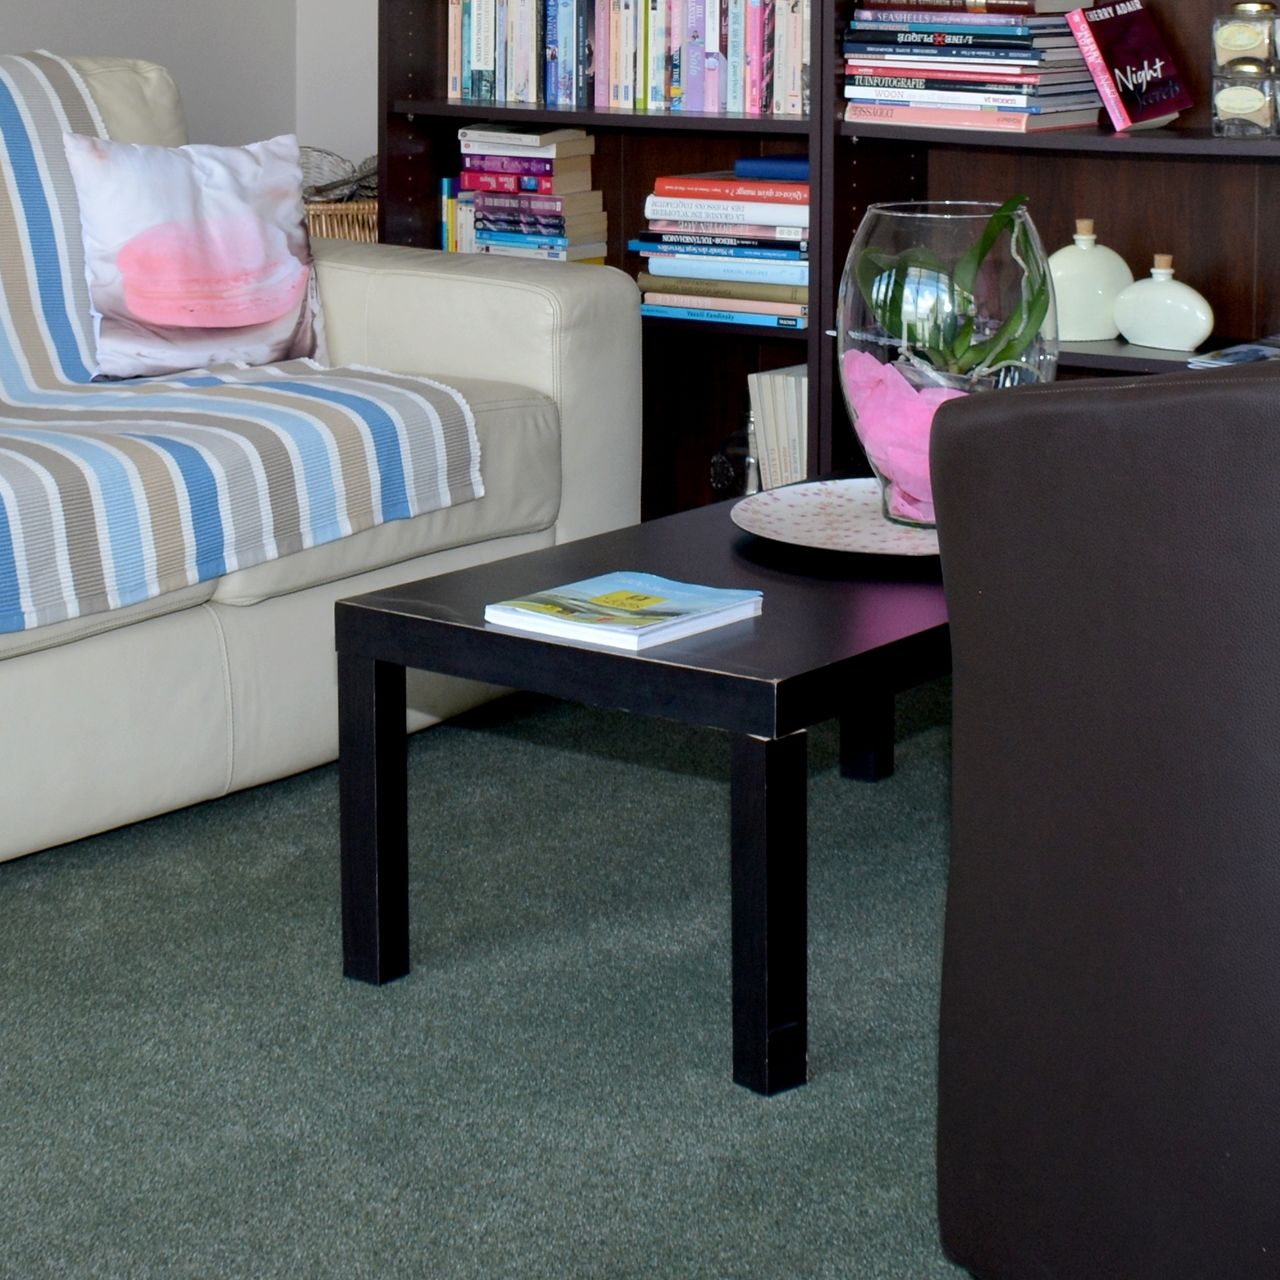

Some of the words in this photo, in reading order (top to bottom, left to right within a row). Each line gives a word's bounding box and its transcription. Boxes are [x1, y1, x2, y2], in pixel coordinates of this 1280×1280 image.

[875, 11, 929, 23] SEASHELLS
[689, 49, 702, 77] Solo
[1112, 58, 1164, 93] Night
[853, 75, 924, 90] TUINFOTOGRAFIE
[872, 90, 903, 99] WOON
[704, 312, 733, 322] Kandinsky
